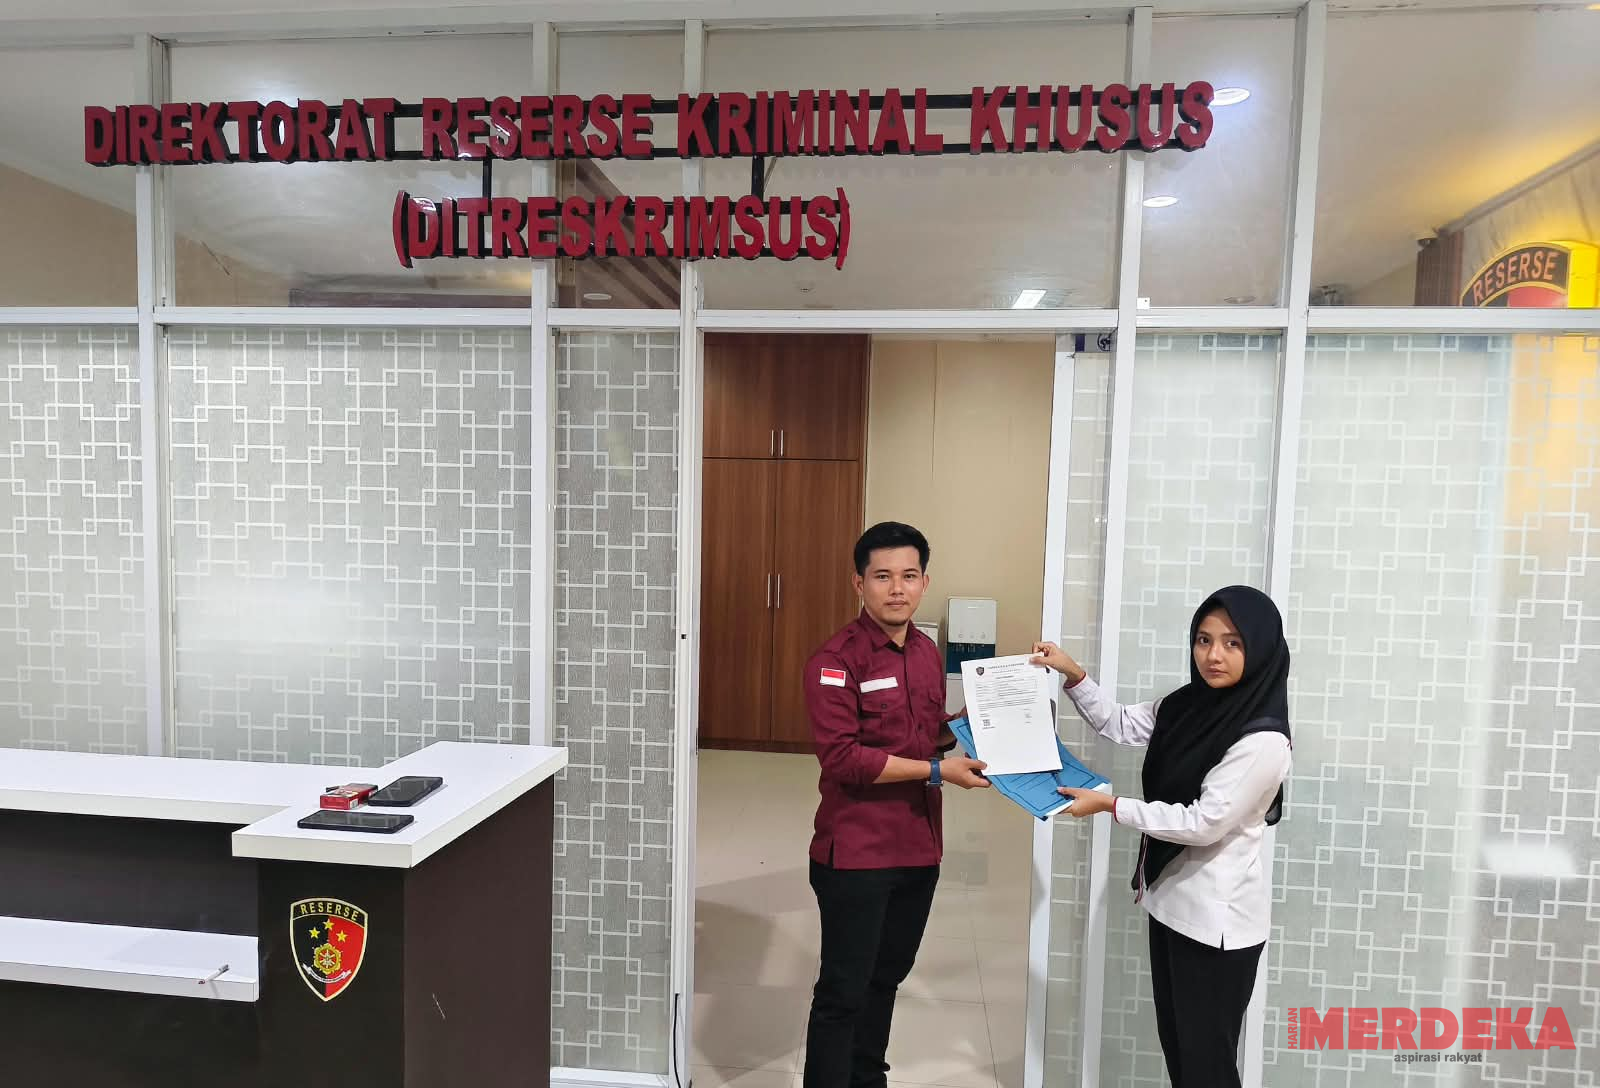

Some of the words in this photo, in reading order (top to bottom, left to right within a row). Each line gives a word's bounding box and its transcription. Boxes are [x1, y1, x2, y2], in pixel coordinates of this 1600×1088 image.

[84, 97, 398, 166] DIREKTORAT
[422, 94, 654, 160] RESERSE
[677, 88, 944, 157] KRIMINAL
[970, 81, 1214, 153] KHUSUS
[393, 186, 850, 270] (DITRESKRIMSUS)
[1473, 251, 1560, 306] RESERSE
[300, 902, 359, 920] RESERSE
